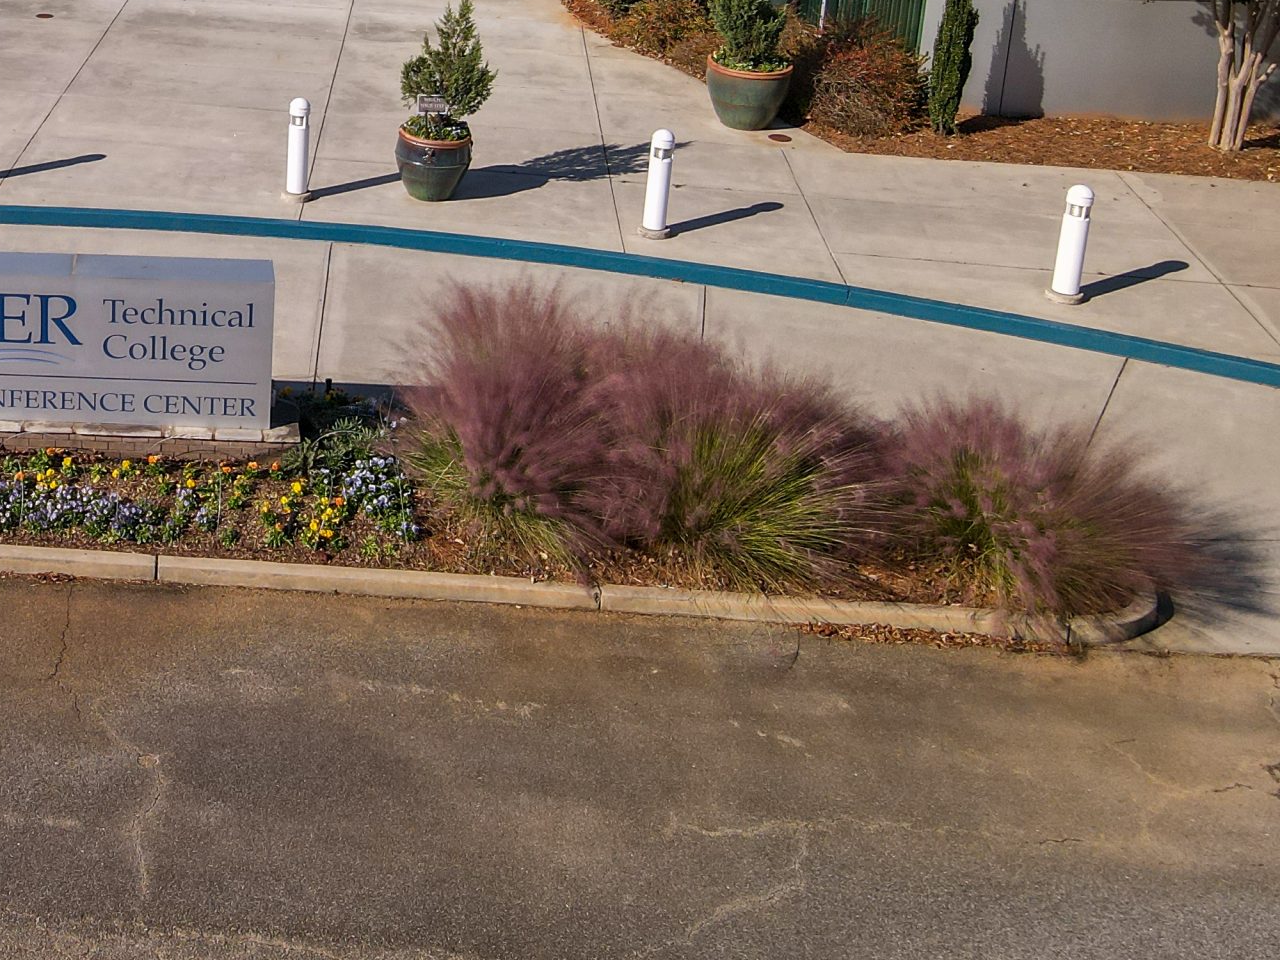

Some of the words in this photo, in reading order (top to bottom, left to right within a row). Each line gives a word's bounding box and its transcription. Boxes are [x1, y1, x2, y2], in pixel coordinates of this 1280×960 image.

[102, 298, 256, 328] Technical
[102, 334, 225, 371] College
[143, 394, 257, 417] CENTER
